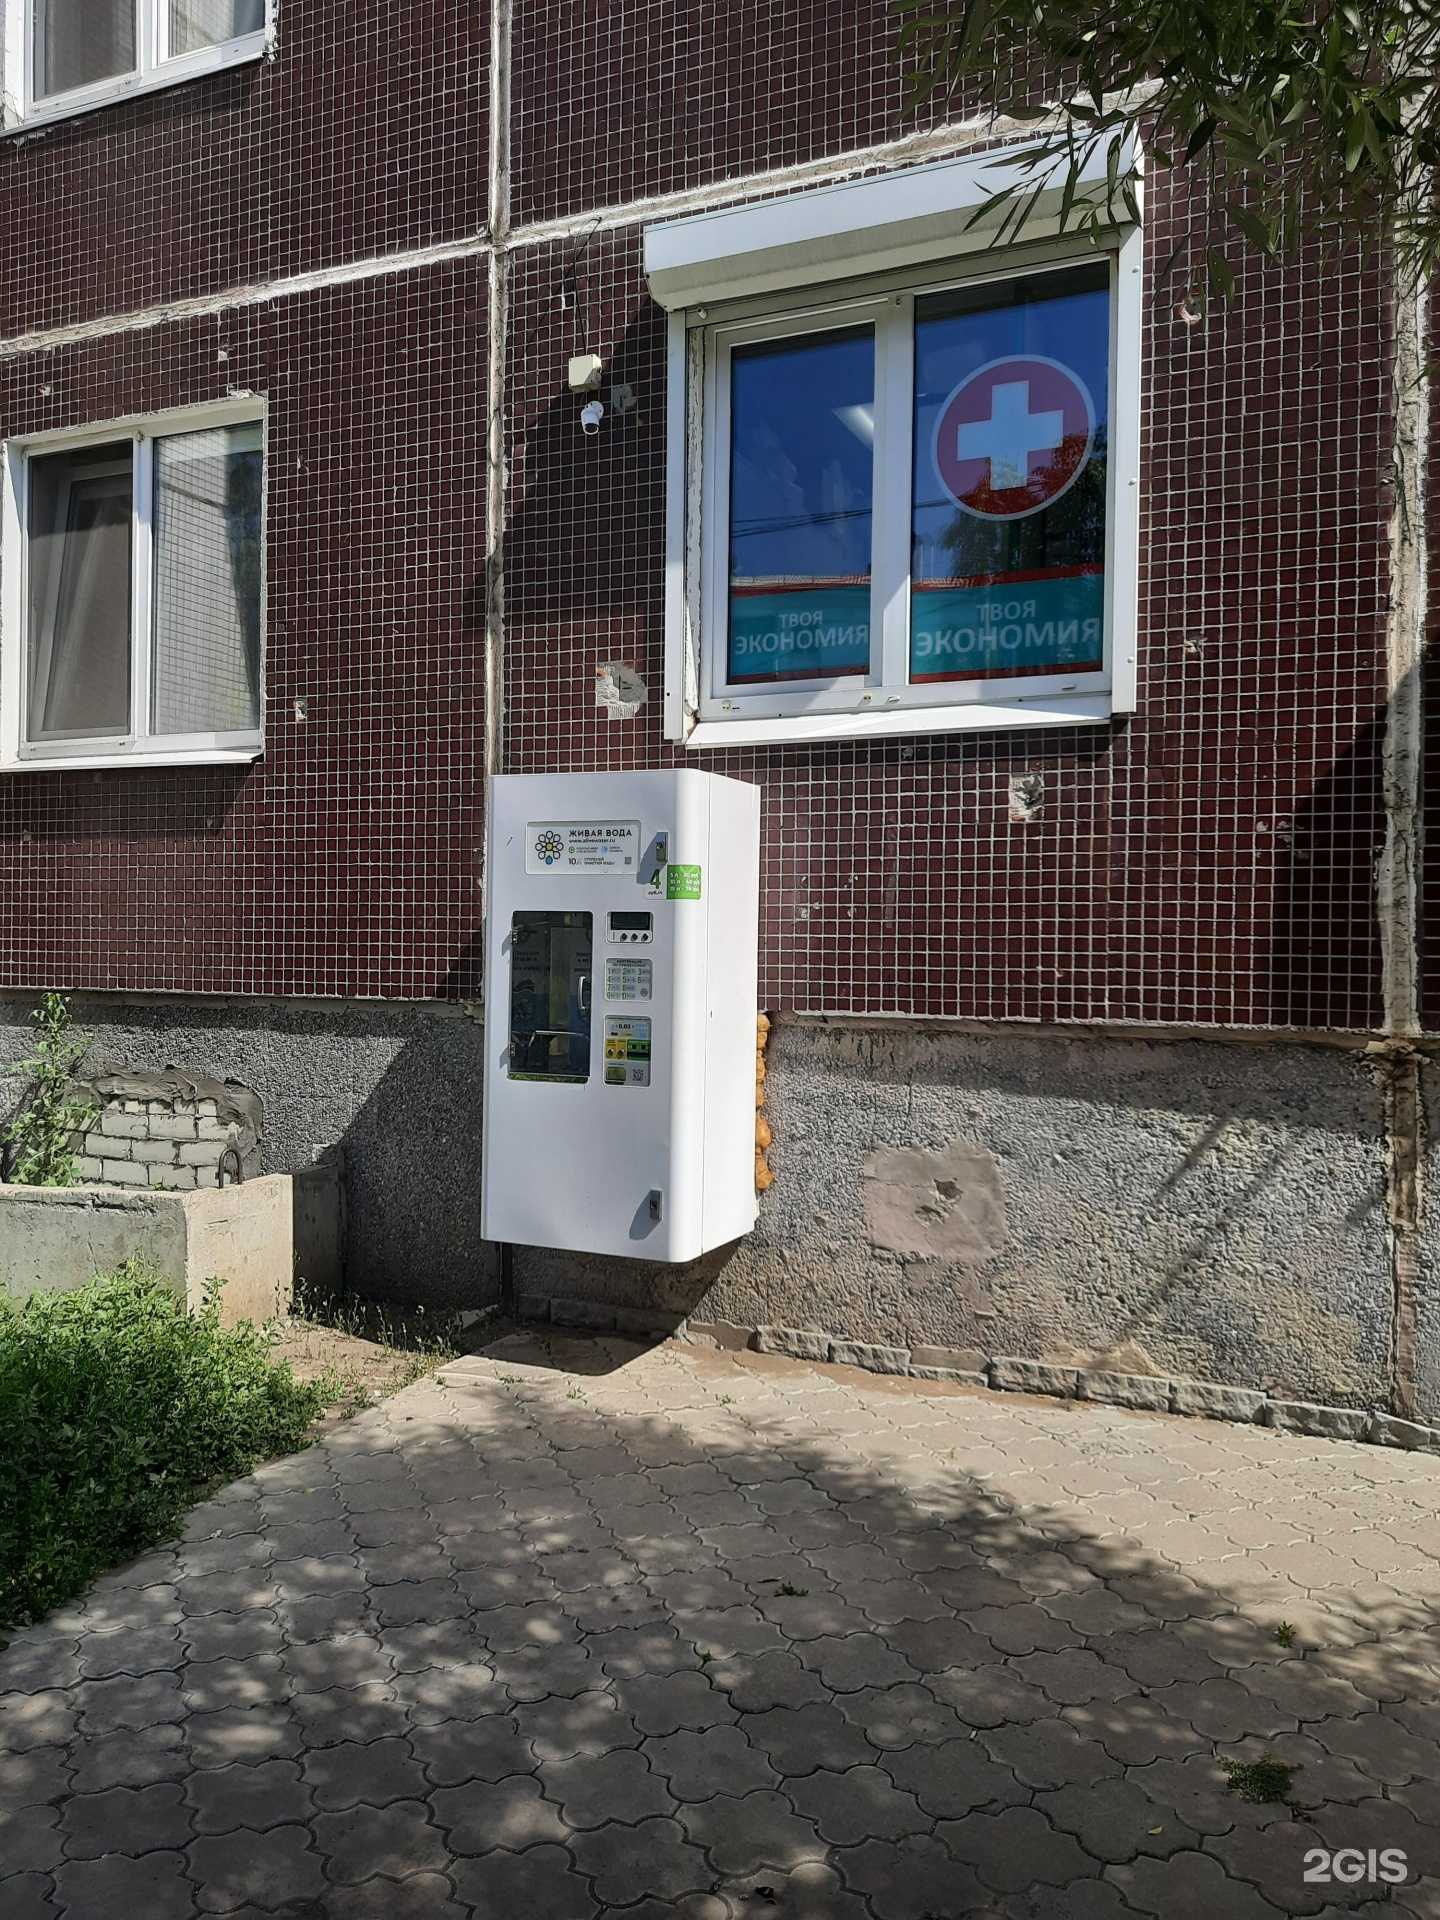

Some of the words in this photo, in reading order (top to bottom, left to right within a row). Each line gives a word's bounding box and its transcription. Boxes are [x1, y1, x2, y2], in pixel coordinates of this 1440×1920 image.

[778, 610, 823, 628] ТВОЯ
[976, 600, 1036, 622] ТВОЯ
[735, 625, 868, 655] ЭКОНОМИЯ
[915, 618, 1099, 657] ЭКОНОМИЯ
[569, 829, 602, 837] ЖИВАЯ
[606, 829, 632, 837] ВОДА
[649, 869, 661, 889] 4
